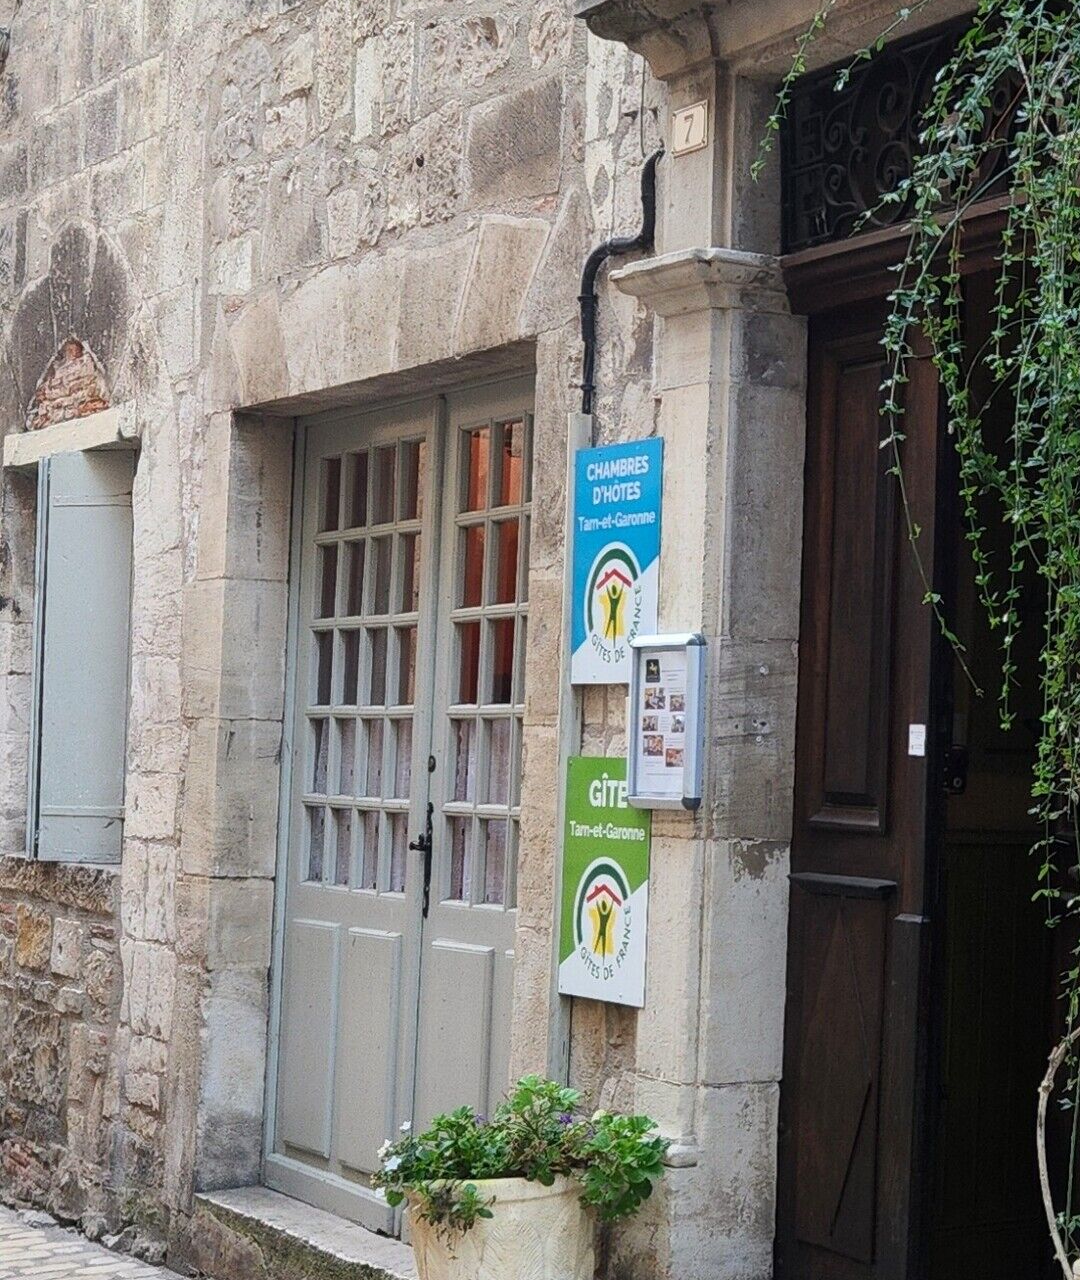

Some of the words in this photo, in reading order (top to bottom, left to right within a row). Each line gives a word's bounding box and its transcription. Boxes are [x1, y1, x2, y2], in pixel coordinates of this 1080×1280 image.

[684, 113, 694, 144] 7
[587, 455, 649, 482] CHAMBRES
[593, 479, 641, 506] D'HÔTES
[578, 511, 656, 532] Tarn-et-Garonne
[615, 646, 625, 663] DE
[569, 820, 645, 841] Tarn-et-Garonne
[603, 964, 614, 981] DE
[616, 905, 631, 968] FRANCE
